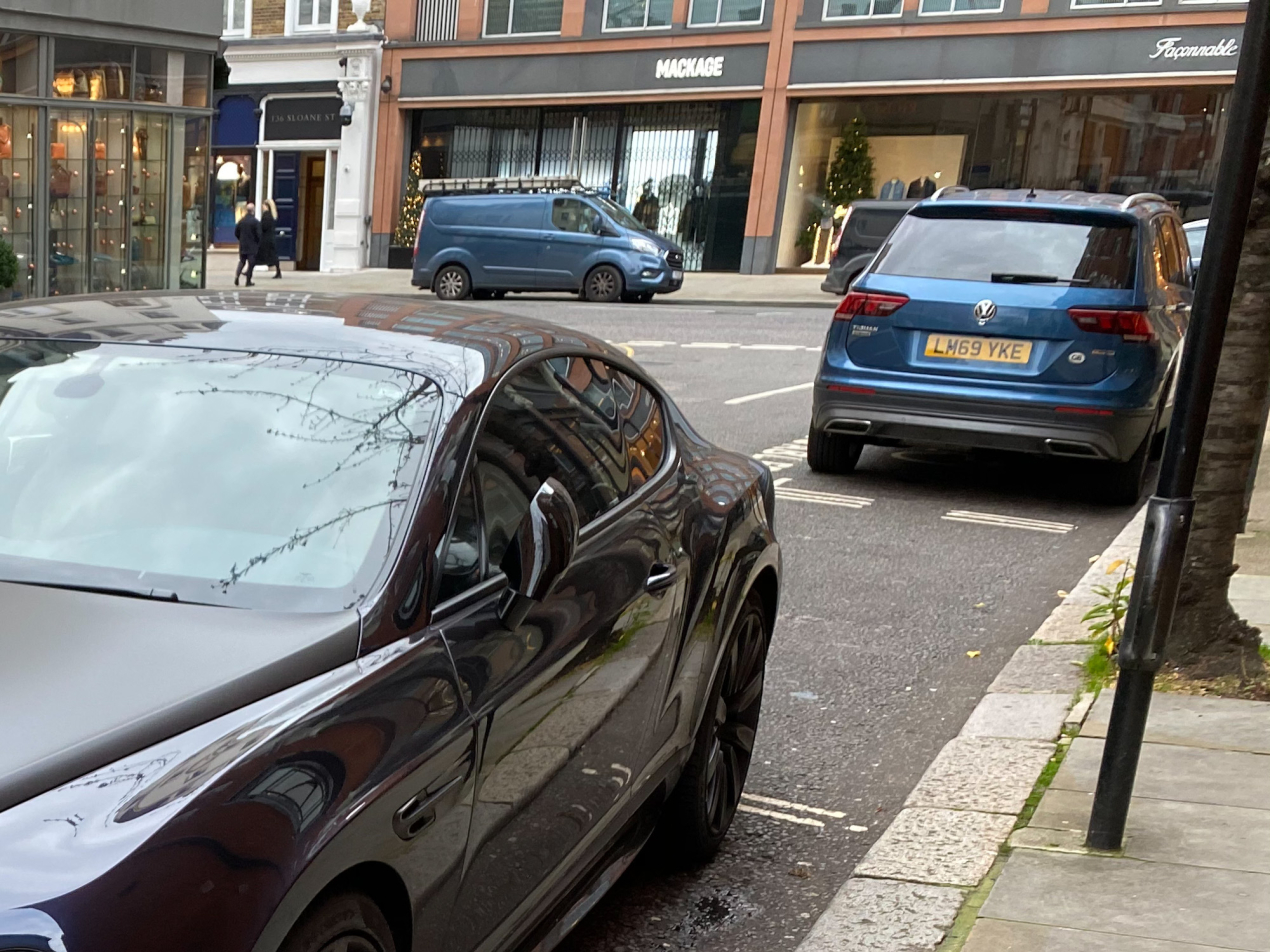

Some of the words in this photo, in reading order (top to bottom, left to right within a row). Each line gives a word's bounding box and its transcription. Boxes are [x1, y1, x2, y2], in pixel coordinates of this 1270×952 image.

[1149, 37, 1238, 60] Façonnable
[655, 56, 725, 79] MACKAGE
[287, 113, 321, 122] SLOANE
[325, 112, 336, 121] ST
[933, 337, 983, 356] LM69
[988, 341, 1024, 360] YKE
